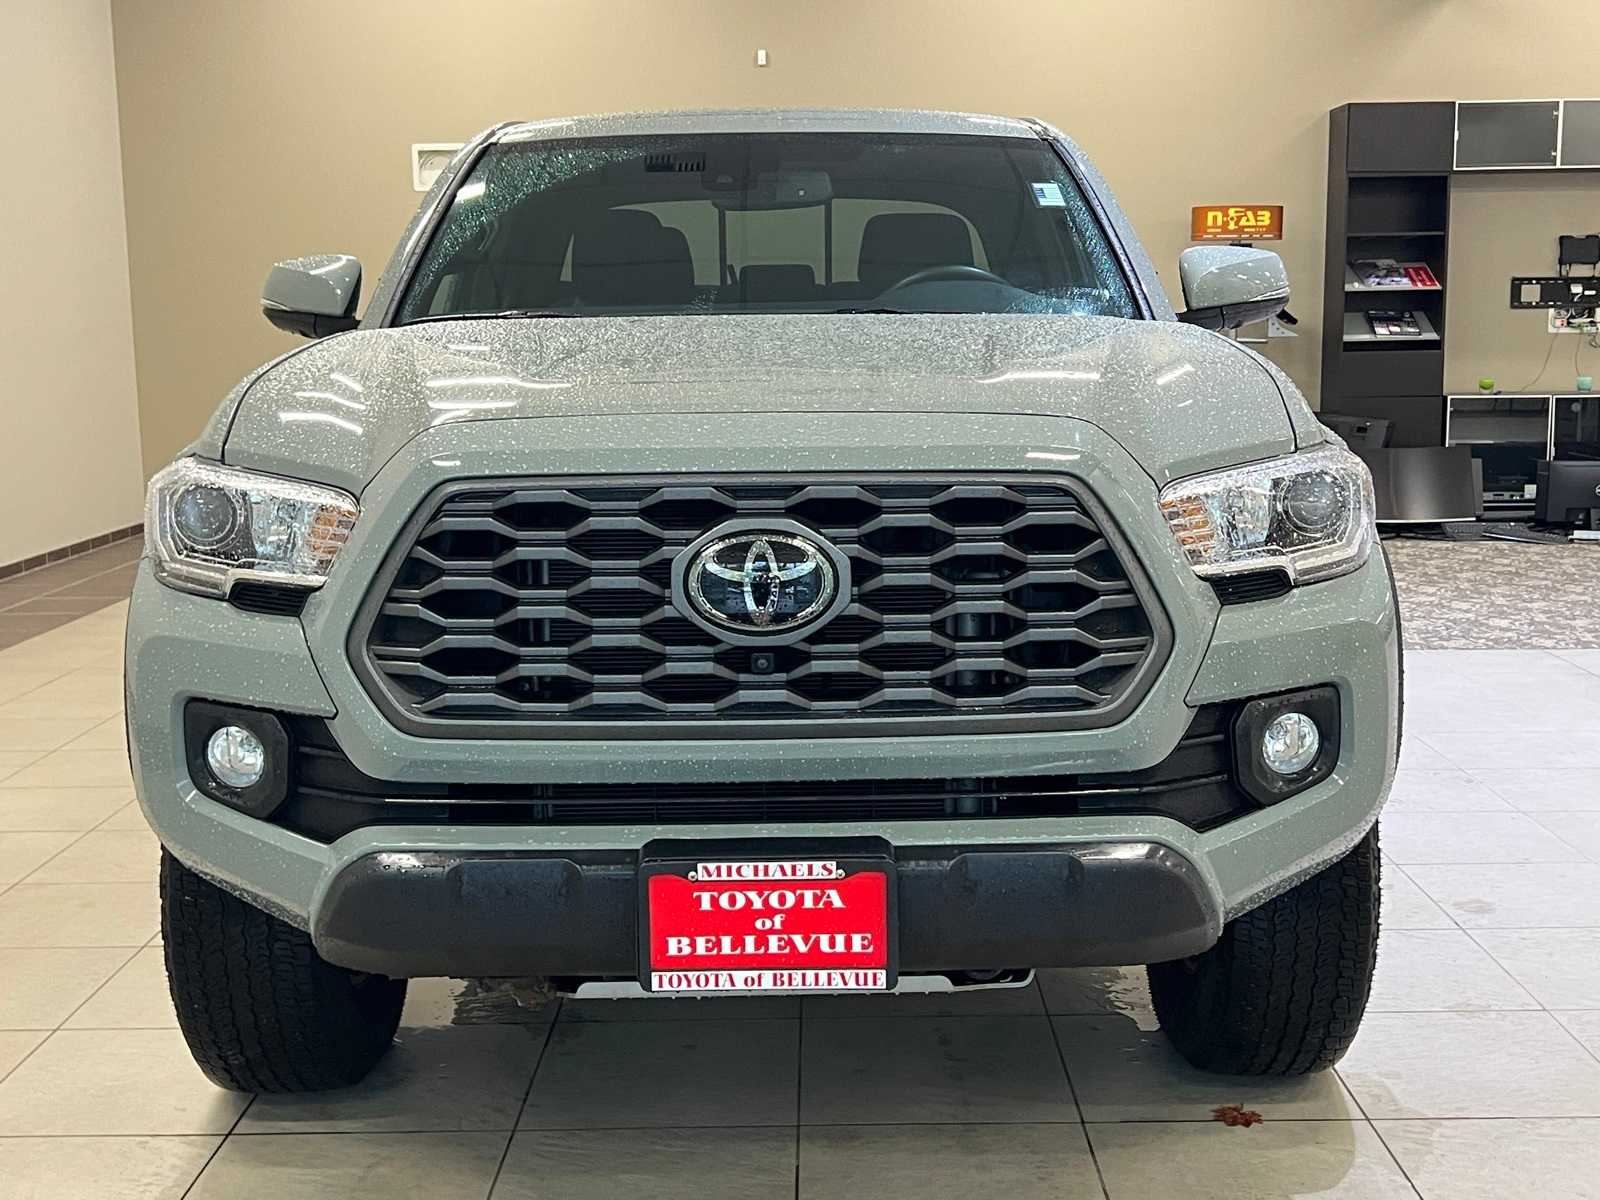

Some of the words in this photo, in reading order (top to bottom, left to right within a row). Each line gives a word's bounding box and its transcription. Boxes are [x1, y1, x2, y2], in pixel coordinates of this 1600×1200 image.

[701, 864, 834, 878] MICHAELS
[693, 889, 845, 910] TOYOTA
[754, 914, 786, 931] of
[666, 933, 874, 956] BELLEVUE
[654, 973, 737, 988] TOYOTA
[743, 972, 764, 987] of
[772, 971, 884, 987] BELLEVUE
